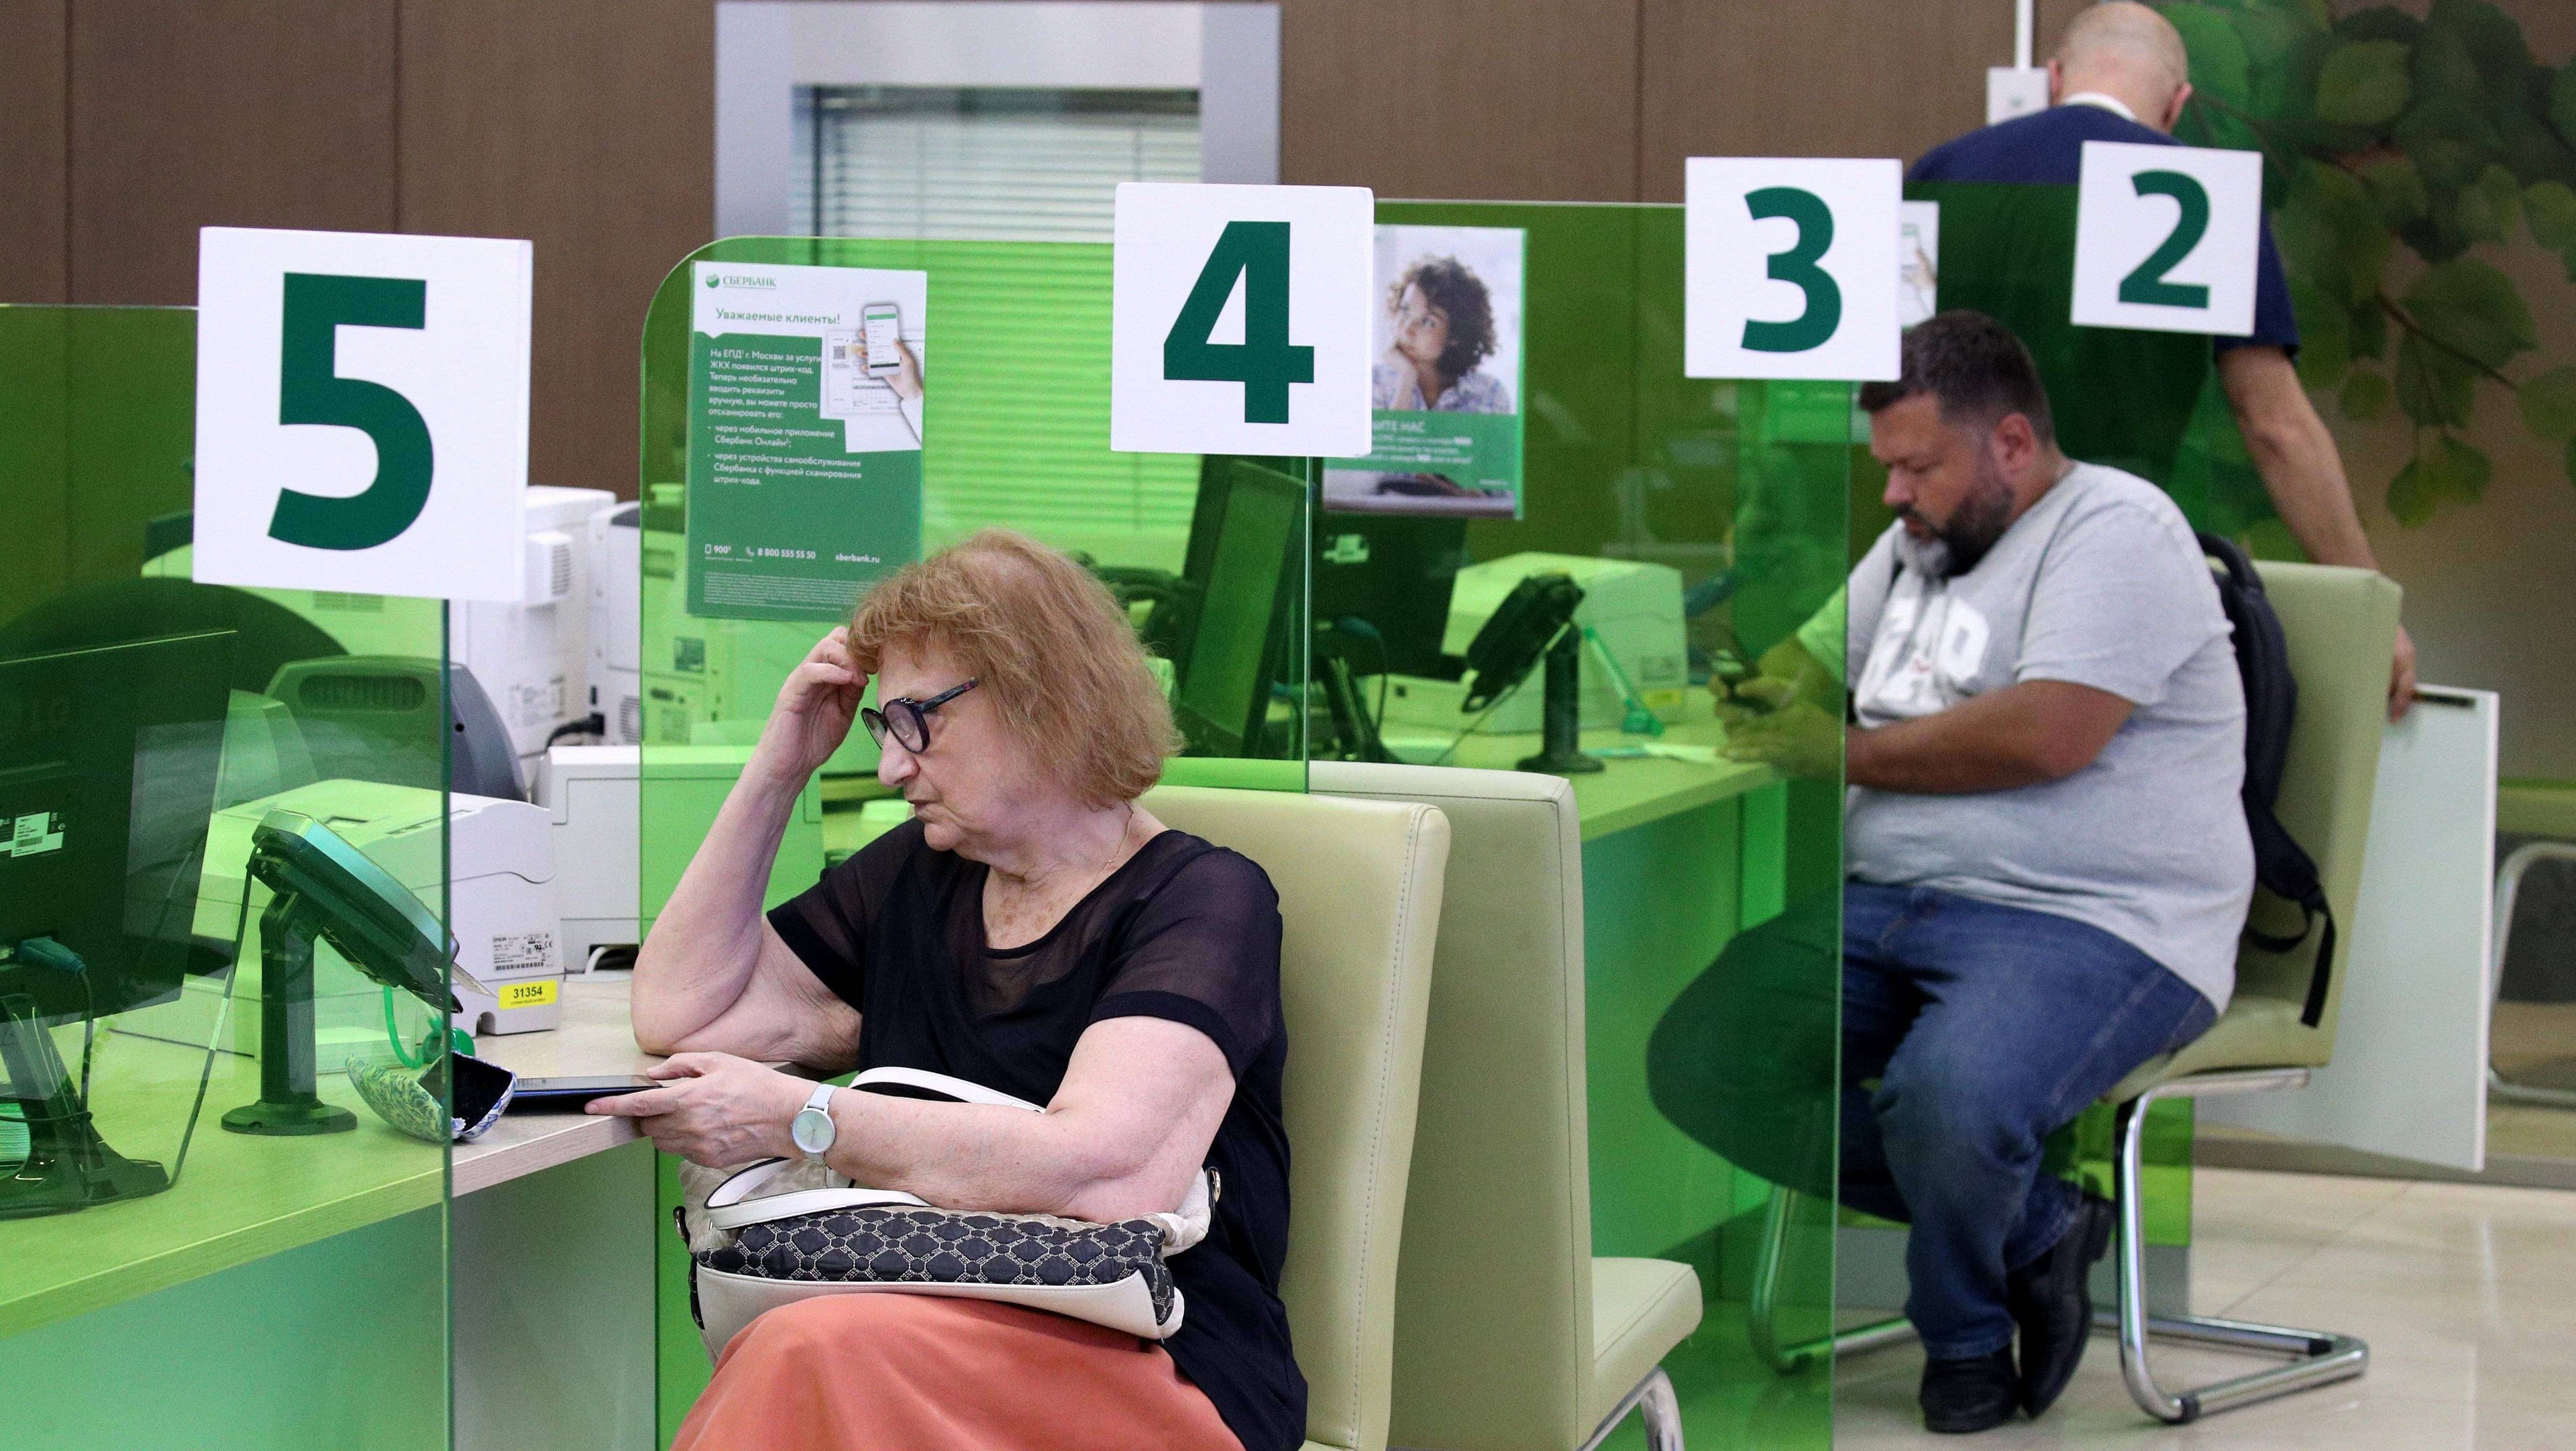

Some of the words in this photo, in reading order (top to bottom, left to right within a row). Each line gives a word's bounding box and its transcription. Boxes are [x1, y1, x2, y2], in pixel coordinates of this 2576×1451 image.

[2118, 170, 2210, 309] 2
[1741, 186, 1842, 353] 3
[723, 275, 776, 287] СБЕРБАНК
[716, 308, 783, 321] Уважаемые
[786, 313, 840, 325] клиенты!
[1163, 221, 1315, 425] 4
[710, 349, 722, 358] На
[751, 351, 784, 361] Москвы
[795, 355, 822, 364] услуги
[710, 360, 730, 369] ЖКХ
[732, 363, 768, 371] появился
[709, 372, 737, 382] Теперь
[739, 374, 797, 384] необязательно
[709, 385, 741, 394] вводить
[742, 387, 784, 395] реквизиты
[268, 272, 434, 551] 5
[789, 401, 817, 409] просто
[708, 409, 766, 418] отсканировать
[715, 425, 738, 434] через
[739, 425, 783, 435] мобильное
[785, 429, 835, 438] приложение
[715, 435, 753, 445] Сбербанк
[739, 454, 783, 464] устройства
[784, 457, 861, 467] самообслуживания
[714, 463, 757, 474] Сбербанка
[764, 466, 804, 476] функцией
[806, 470, 861, 479] сканирования
[765, 548, 779, 557] 800
[781, 549, 794, 558] 555
[796, 550, 805, 558] 55
[806, 551, 816, 559] 50
[836, 553, 880, 563] sberbank.ru
[513, 985, 543, 999] 31354
